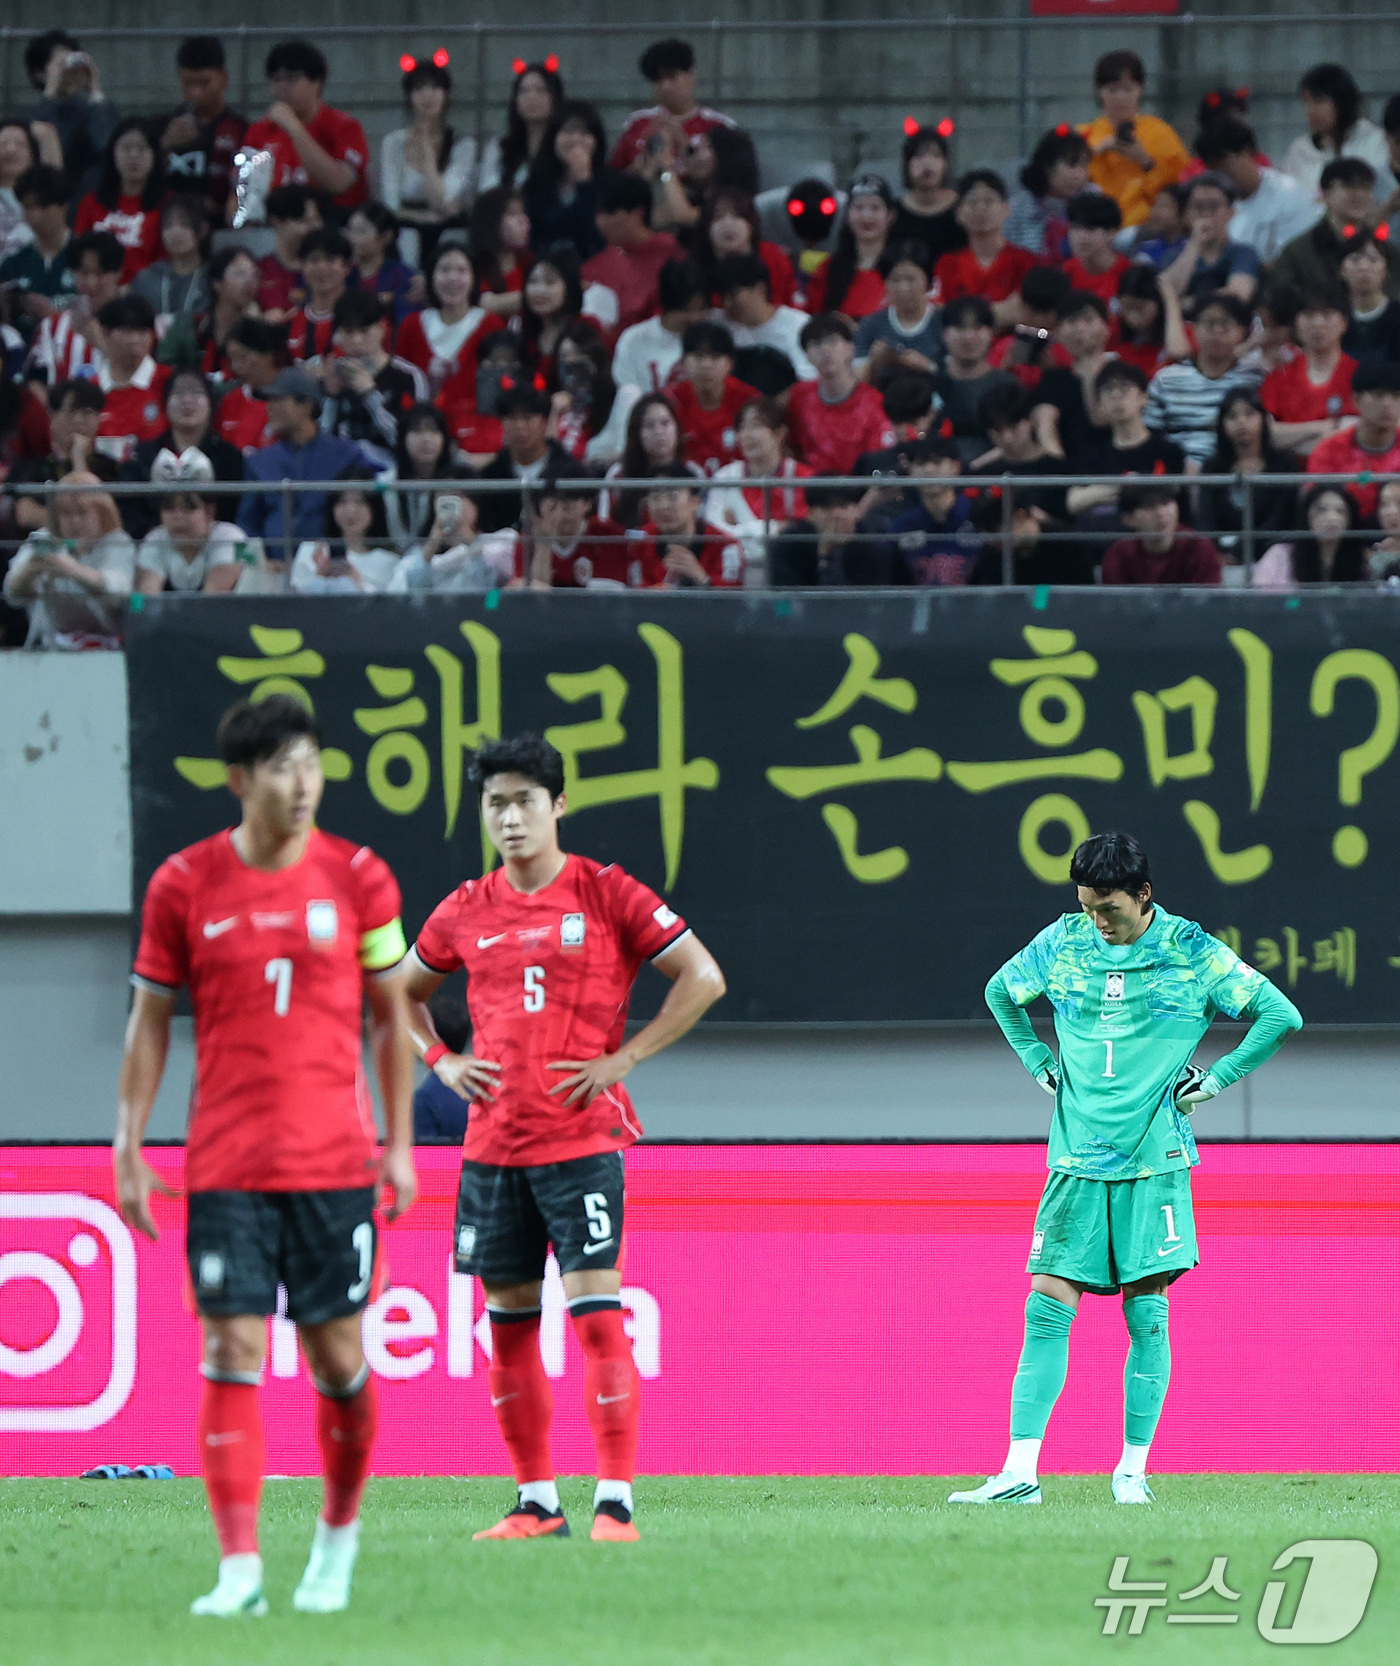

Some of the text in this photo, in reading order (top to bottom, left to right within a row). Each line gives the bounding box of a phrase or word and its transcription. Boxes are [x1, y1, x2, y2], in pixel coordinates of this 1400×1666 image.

[766, 625, 1400, 884] 손흥민?
[1214, 925, 1357, 988] 카페
[264, 957, 293, 1017] 7
[523, 965, 546, 1013] 5
[1101, 1040, 1117, 1078] 1
[583, 1191, 612, 1241] 5
[1160, 1204, 1181, 1242] 1
